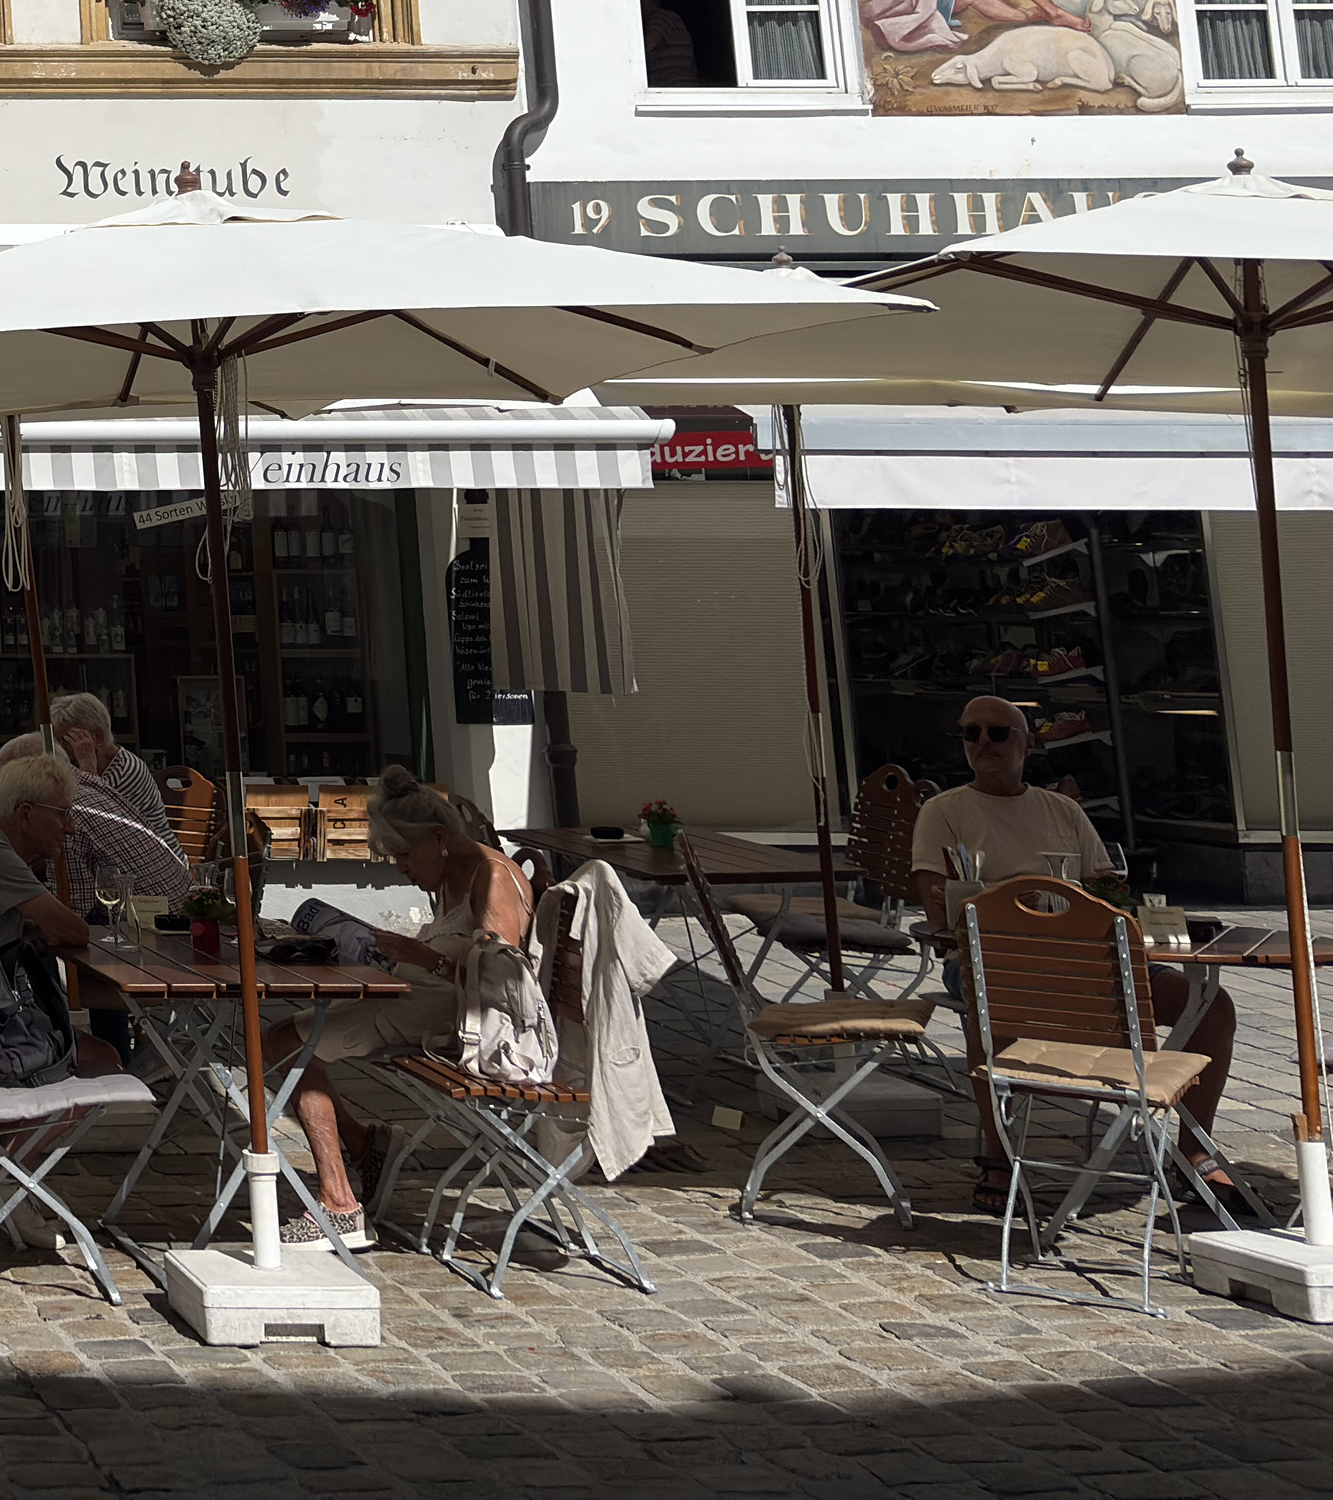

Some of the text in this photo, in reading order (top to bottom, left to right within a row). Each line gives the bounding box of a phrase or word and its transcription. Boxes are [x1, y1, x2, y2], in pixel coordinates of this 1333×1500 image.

[570, 200, 607, 236] 19
[249, 451, 402, 484] einhaus
[138, 513, 152, 525] 44
[155, 505, 193, 522] Sorten
